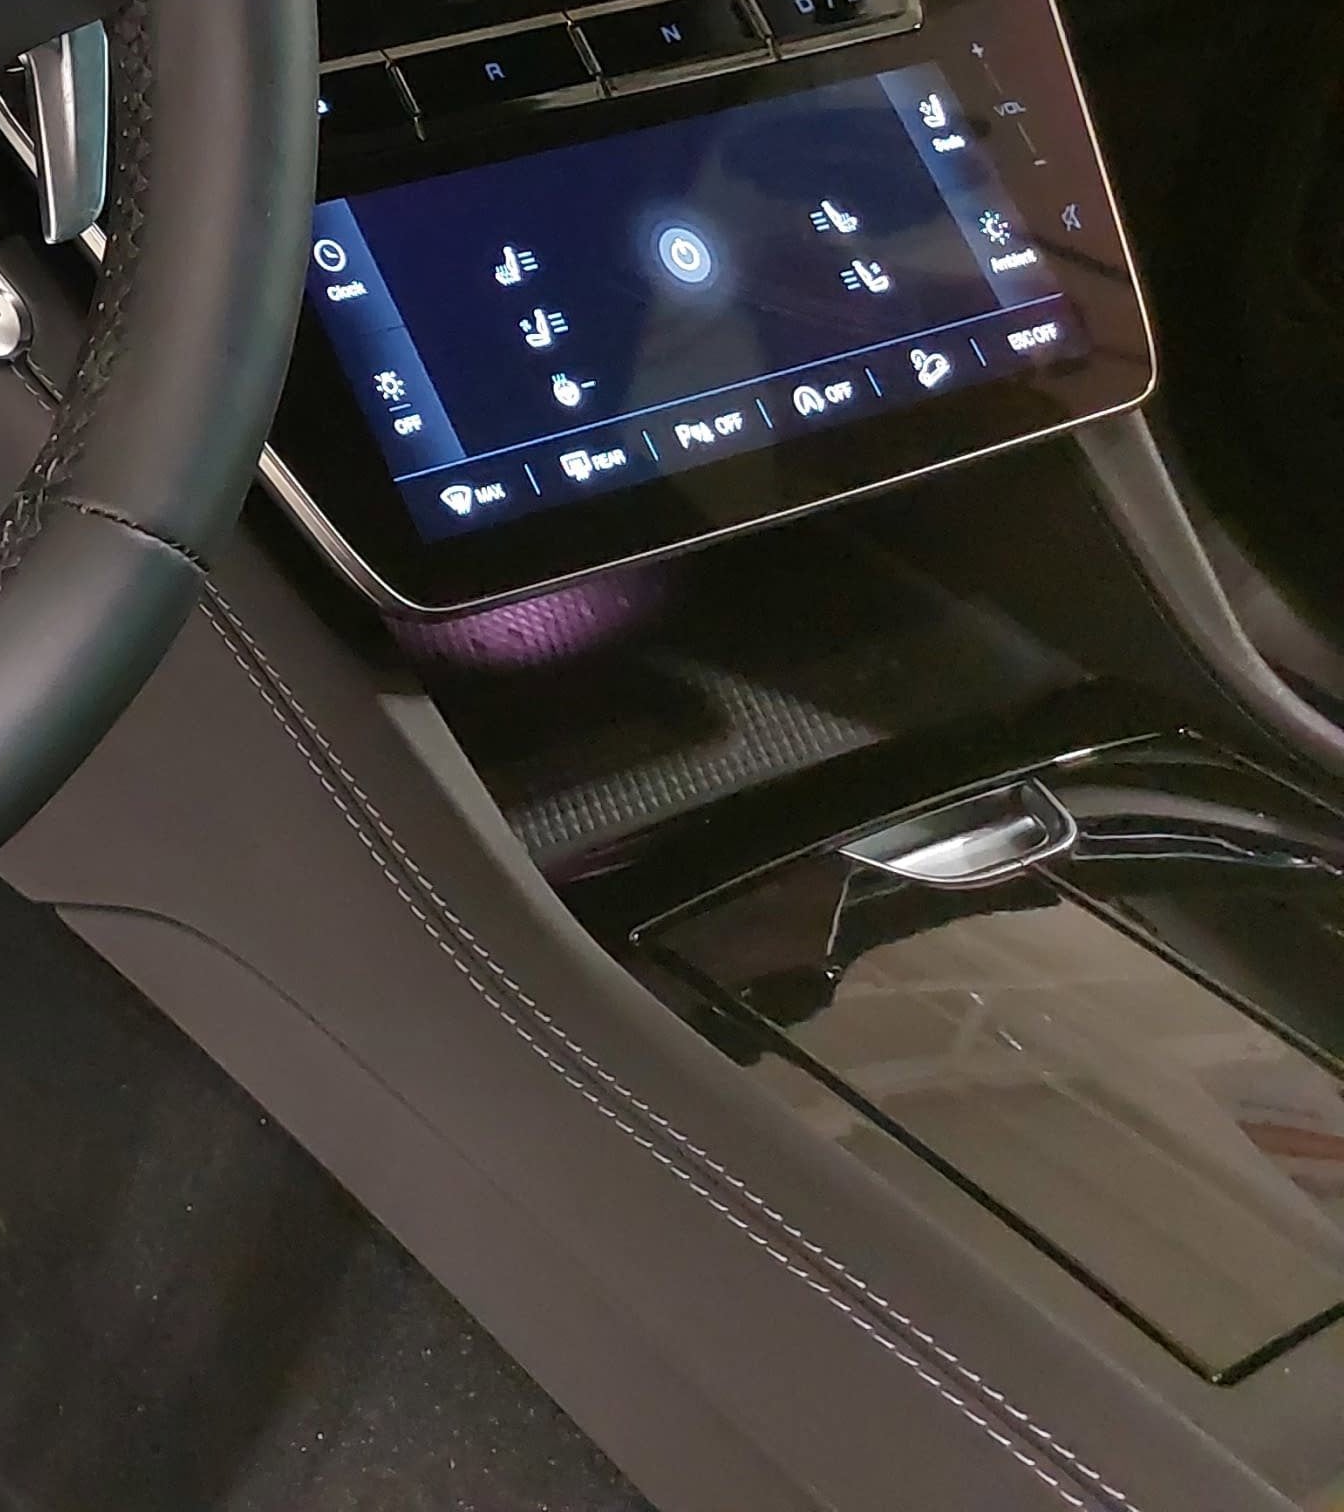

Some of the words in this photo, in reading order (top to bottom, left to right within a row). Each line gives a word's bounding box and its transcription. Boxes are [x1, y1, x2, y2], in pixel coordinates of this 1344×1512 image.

[484, 62, 506, 82] R
[660, 24, 683, 45] N
[993, 101, 1027, 117] VOL
[327, 279, 369, 302] Clock
[824, 380, 854, 404] OFF
[393, 413, 424, 436] OFF
[714, 411, 744, 436] OFF
[474, 482, 507, 505] MAX
